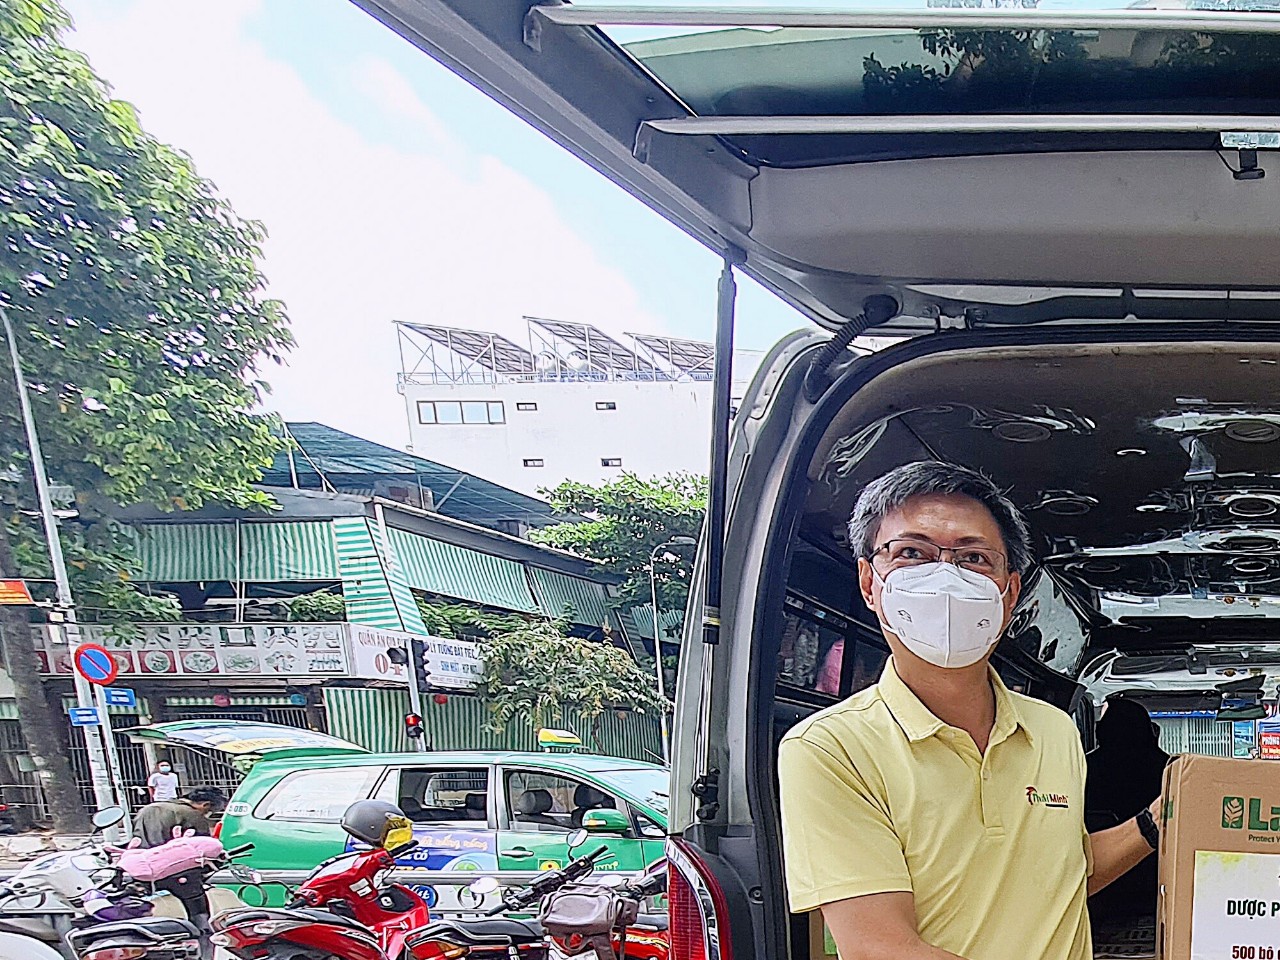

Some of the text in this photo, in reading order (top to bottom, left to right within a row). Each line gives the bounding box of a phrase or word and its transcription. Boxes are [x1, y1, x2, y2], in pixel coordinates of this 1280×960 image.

[1248, 834, 1275, 843] Protect
[1227, 899, 1267, 920] DƯỢC
[1232, 945, 1255, 960] 500
